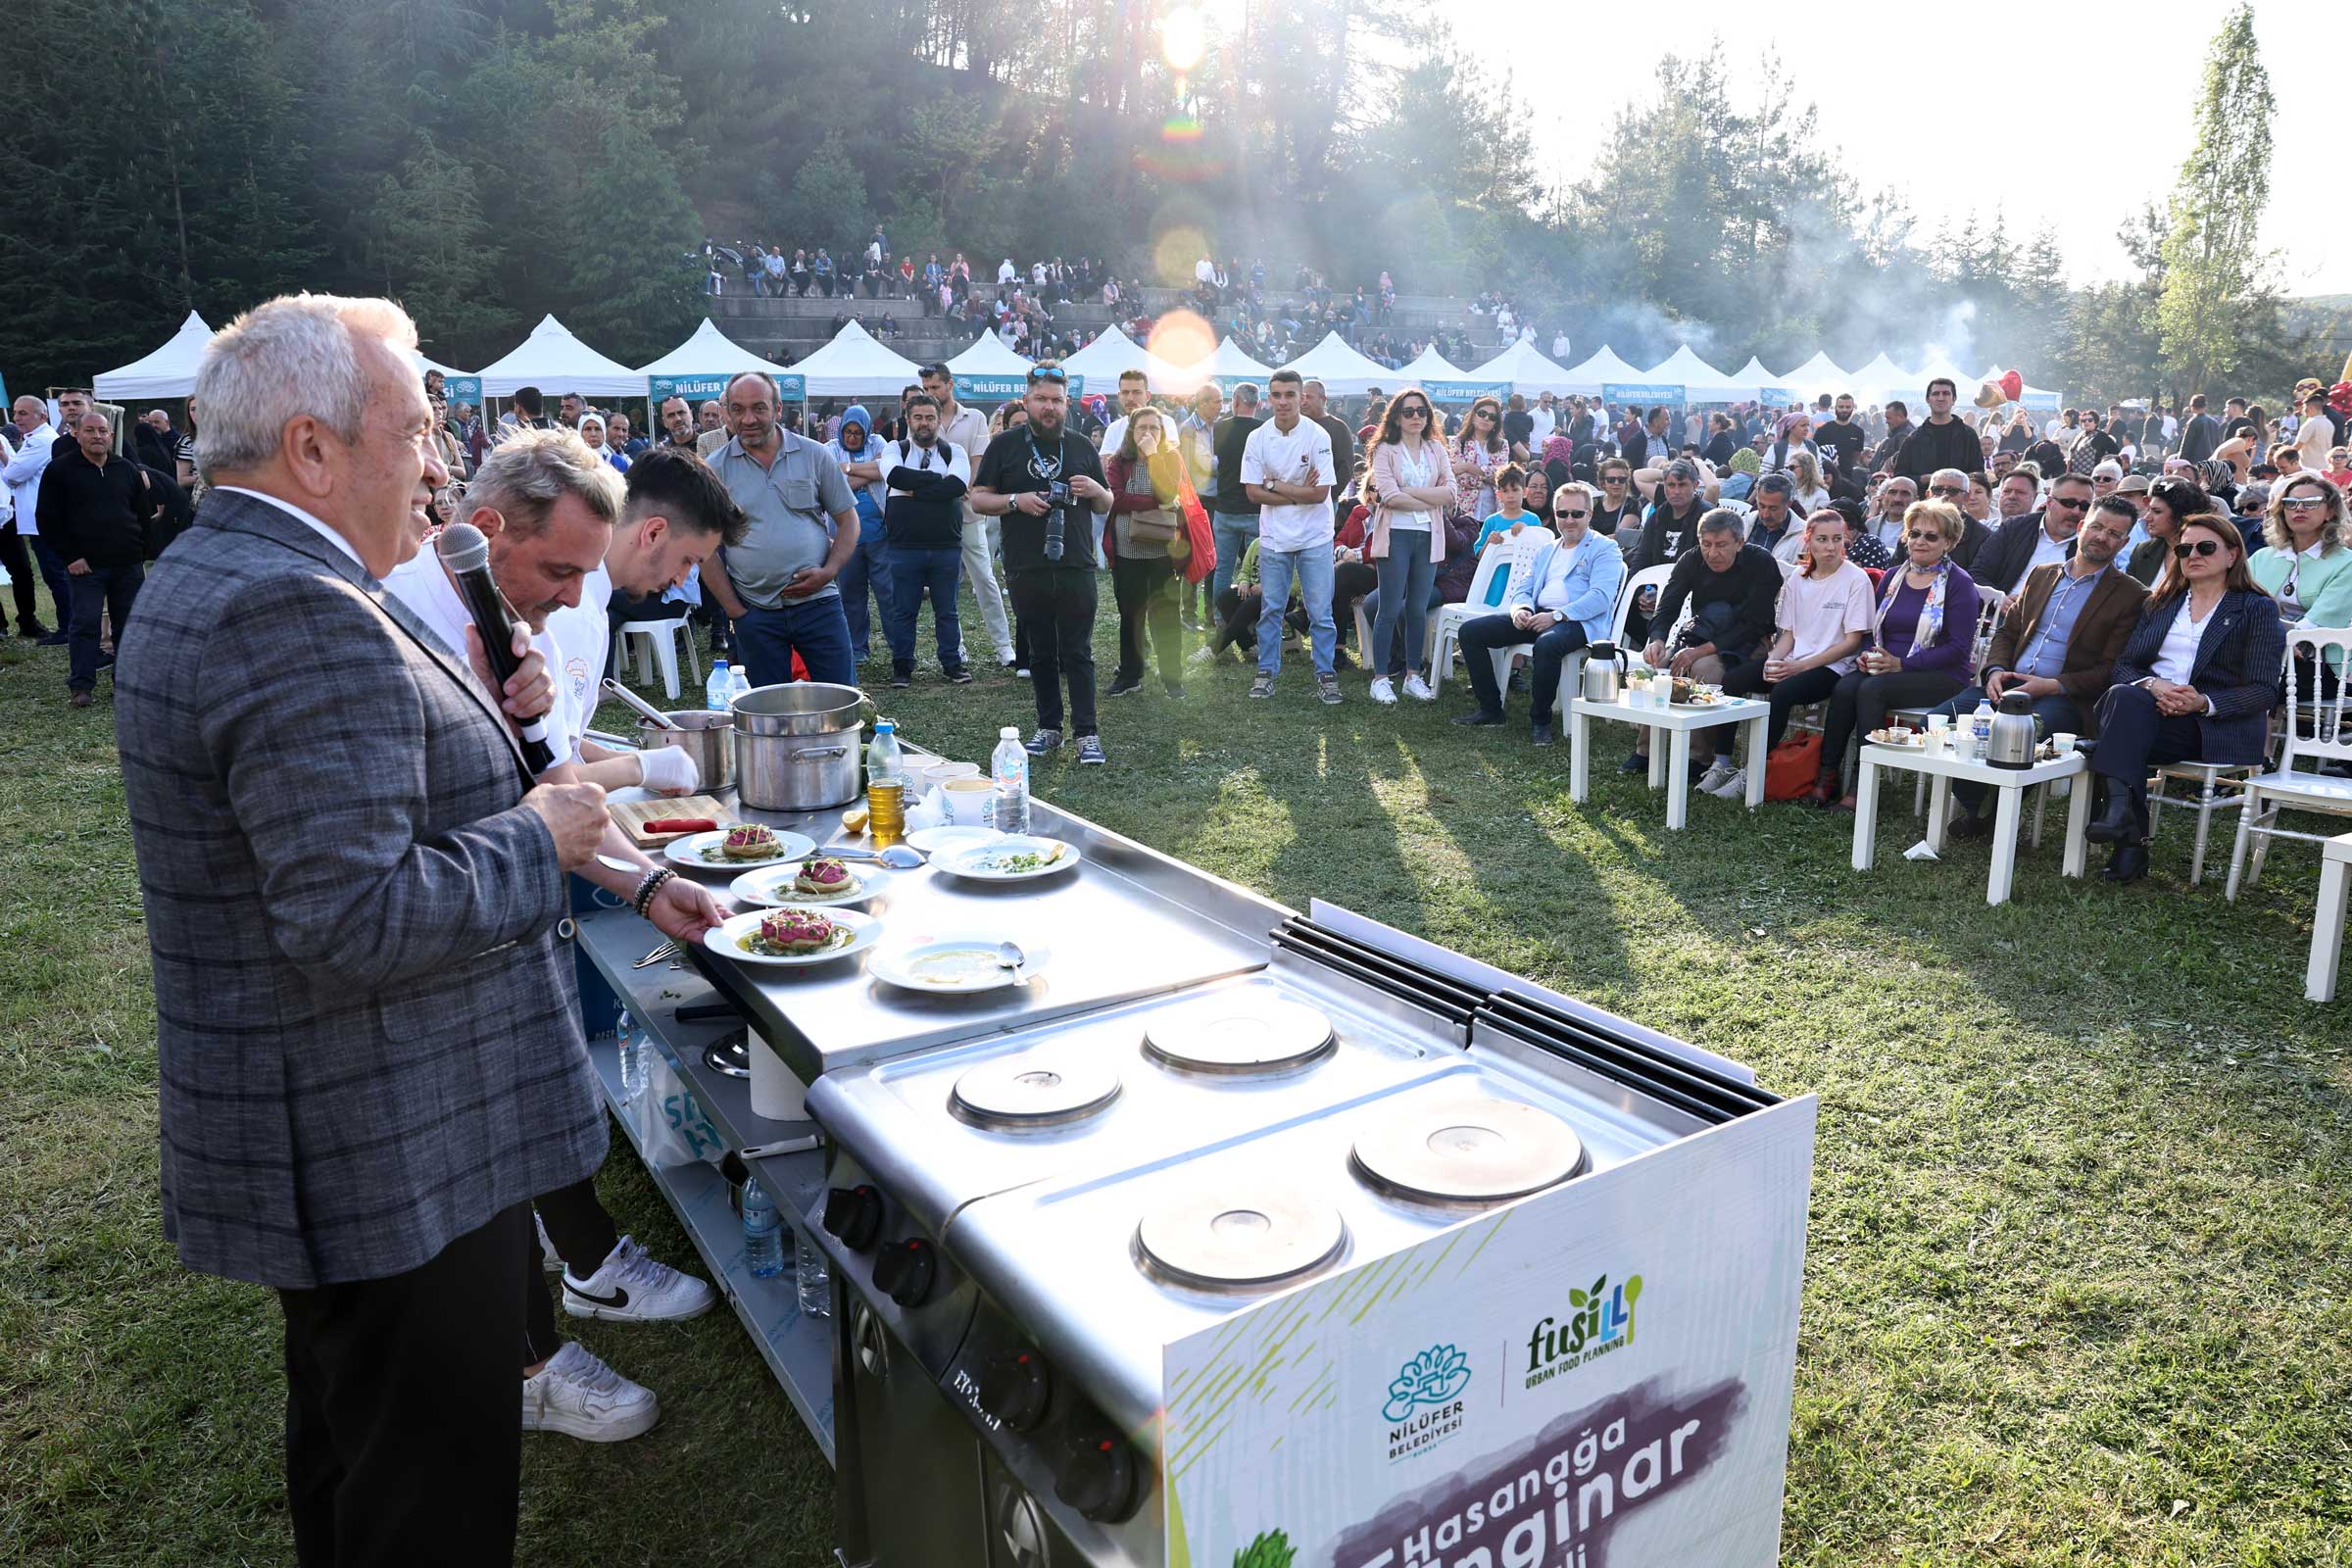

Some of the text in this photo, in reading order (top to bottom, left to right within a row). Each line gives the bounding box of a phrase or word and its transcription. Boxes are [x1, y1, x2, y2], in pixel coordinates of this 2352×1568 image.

[676, 381, 720, 394] NİLÜFER
[973, 381, 1011, 393] NİLÜFER
[1525, 1335, 1625, 1390] URBAN FOOD PLANNING
[1389, 1400, 1464, 1444] NİLÜFER
[1389, 1415, 1462, 1458] BELEDİYESİ
[1402, 1416, 1626, 1565] Hasanağa
